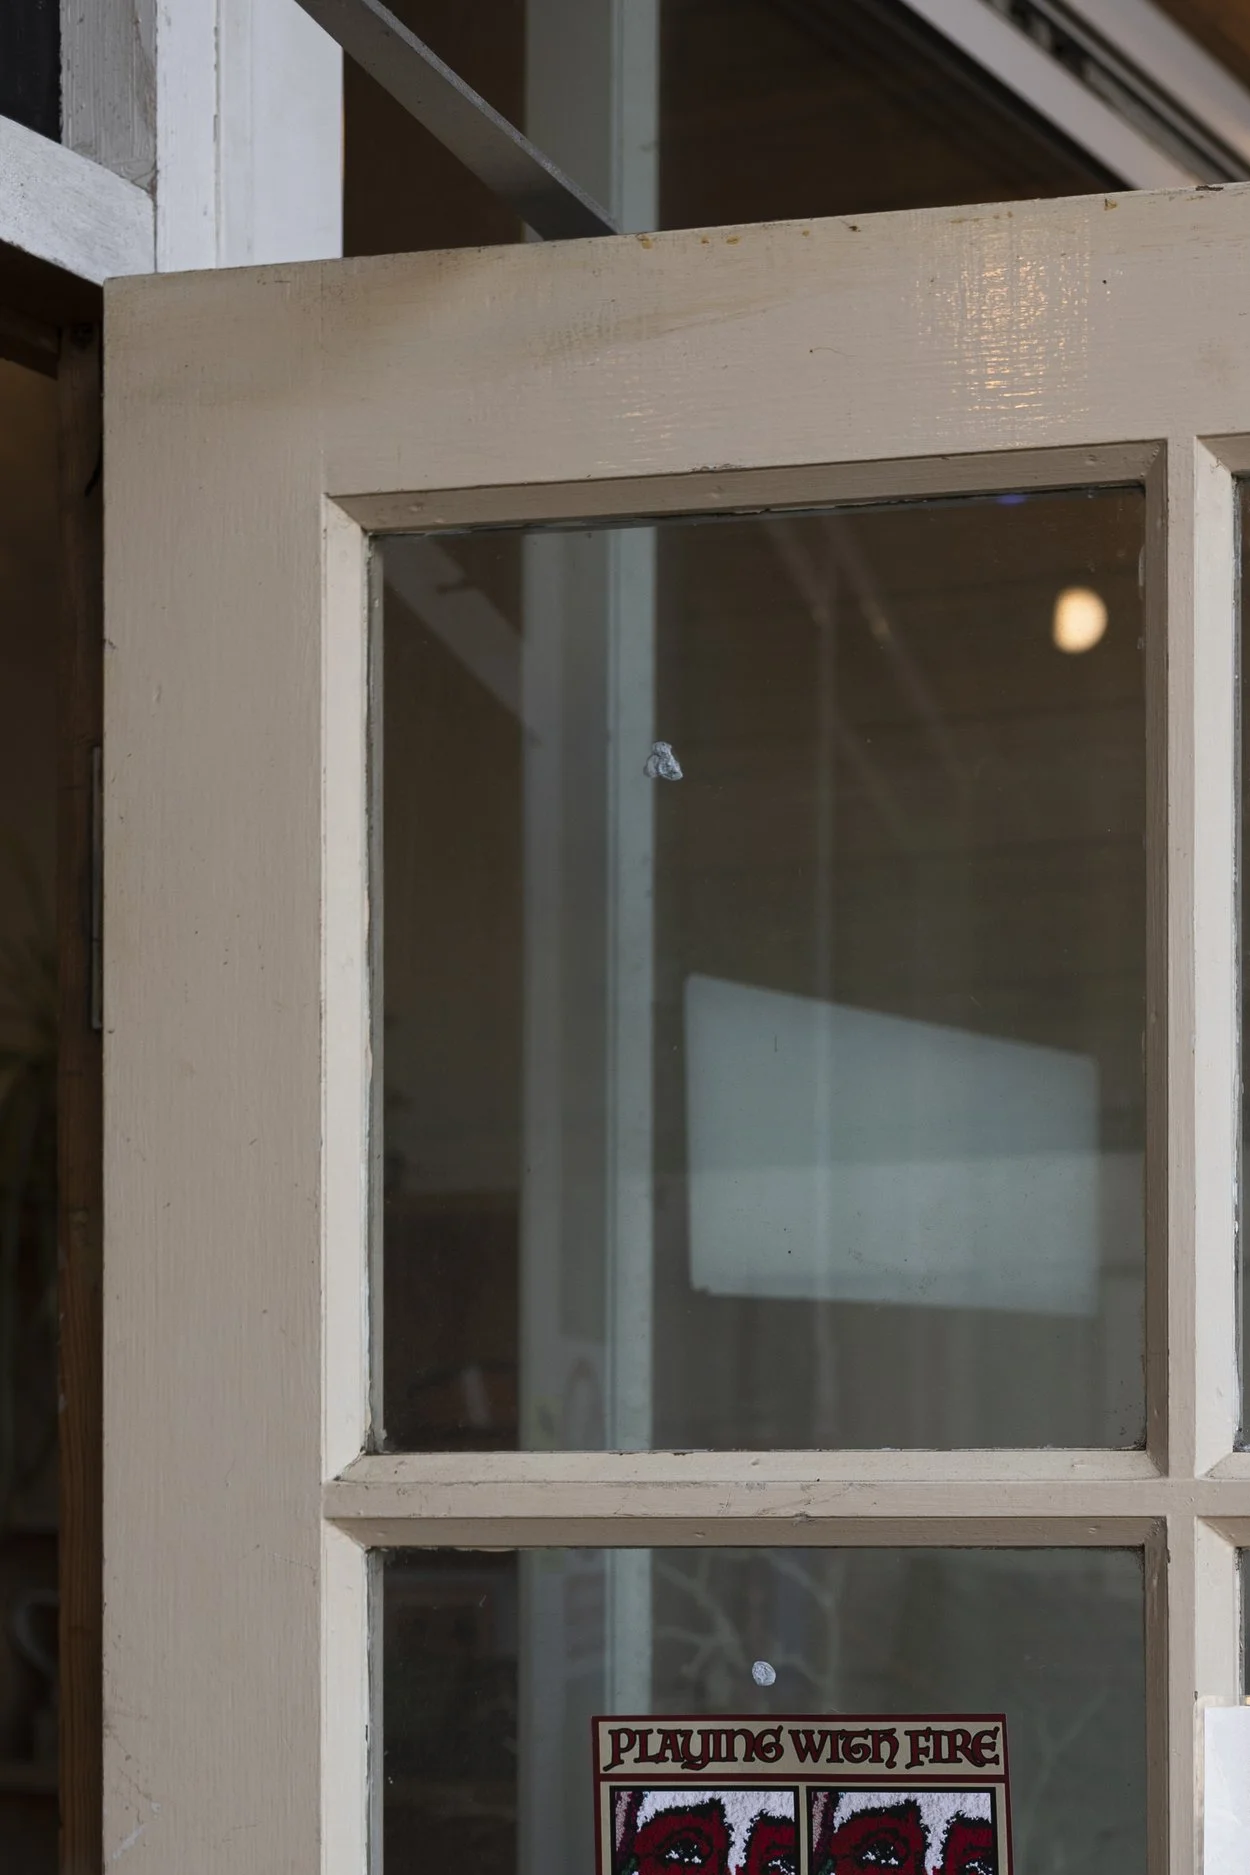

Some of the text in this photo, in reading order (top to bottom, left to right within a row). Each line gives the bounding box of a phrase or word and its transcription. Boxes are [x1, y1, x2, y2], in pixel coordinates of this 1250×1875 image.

[603, 1725, 1000, 1772] PLAYING WITH FIRE
